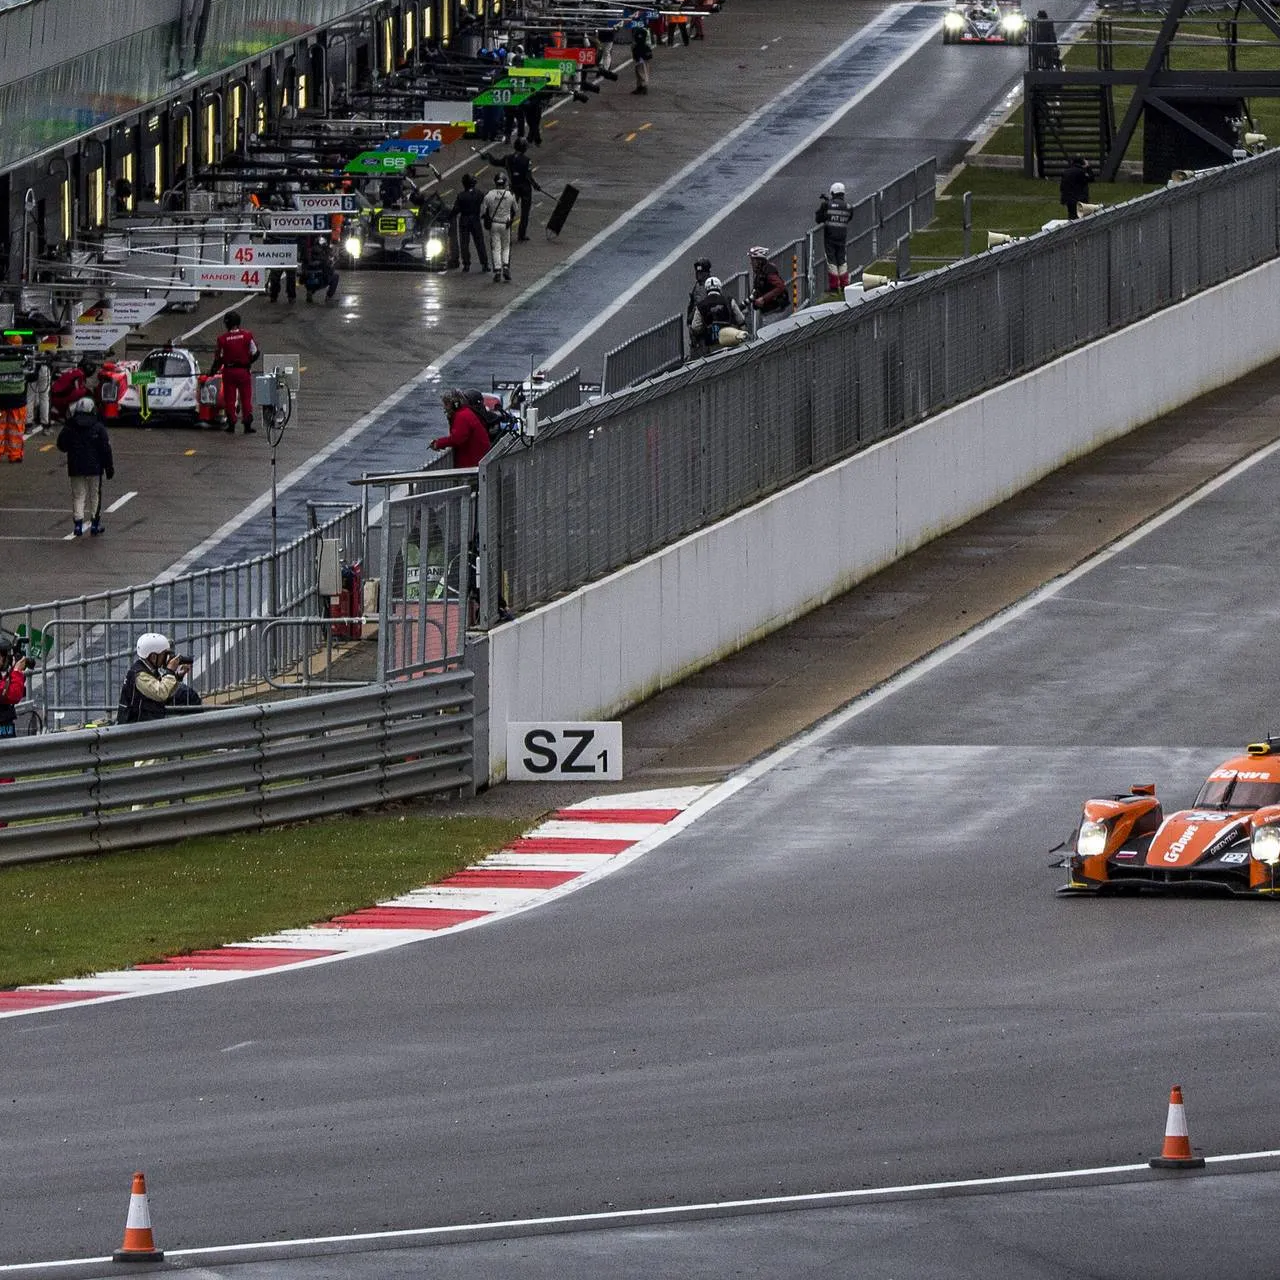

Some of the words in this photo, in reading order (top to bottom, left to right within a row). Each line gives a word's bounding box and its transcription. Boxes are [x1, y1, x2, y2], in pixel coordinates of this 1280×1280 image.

[579, 50, 594, 63] 95
[559, 61, 573, 74] 98
[492, 89, 511, 104] 30
[423, 129, 442, 141] 26
[407, 145, 428, 154] 67
[383, 157, 406, 168] 66
[301, 199, 340, 208] TOYOTA
[344, 198, 353, 210] 6
[273, 218, 313, 226] TOYOTA
[316, 215, 325, 230] 5
[234, 247, 254, 263] 45
[257, 251, 292, 259] MANOR
[240, 270, 260, 285] 44
[94, 310, 104, 322] 2
[1223, 852, 1246, 863] P2
